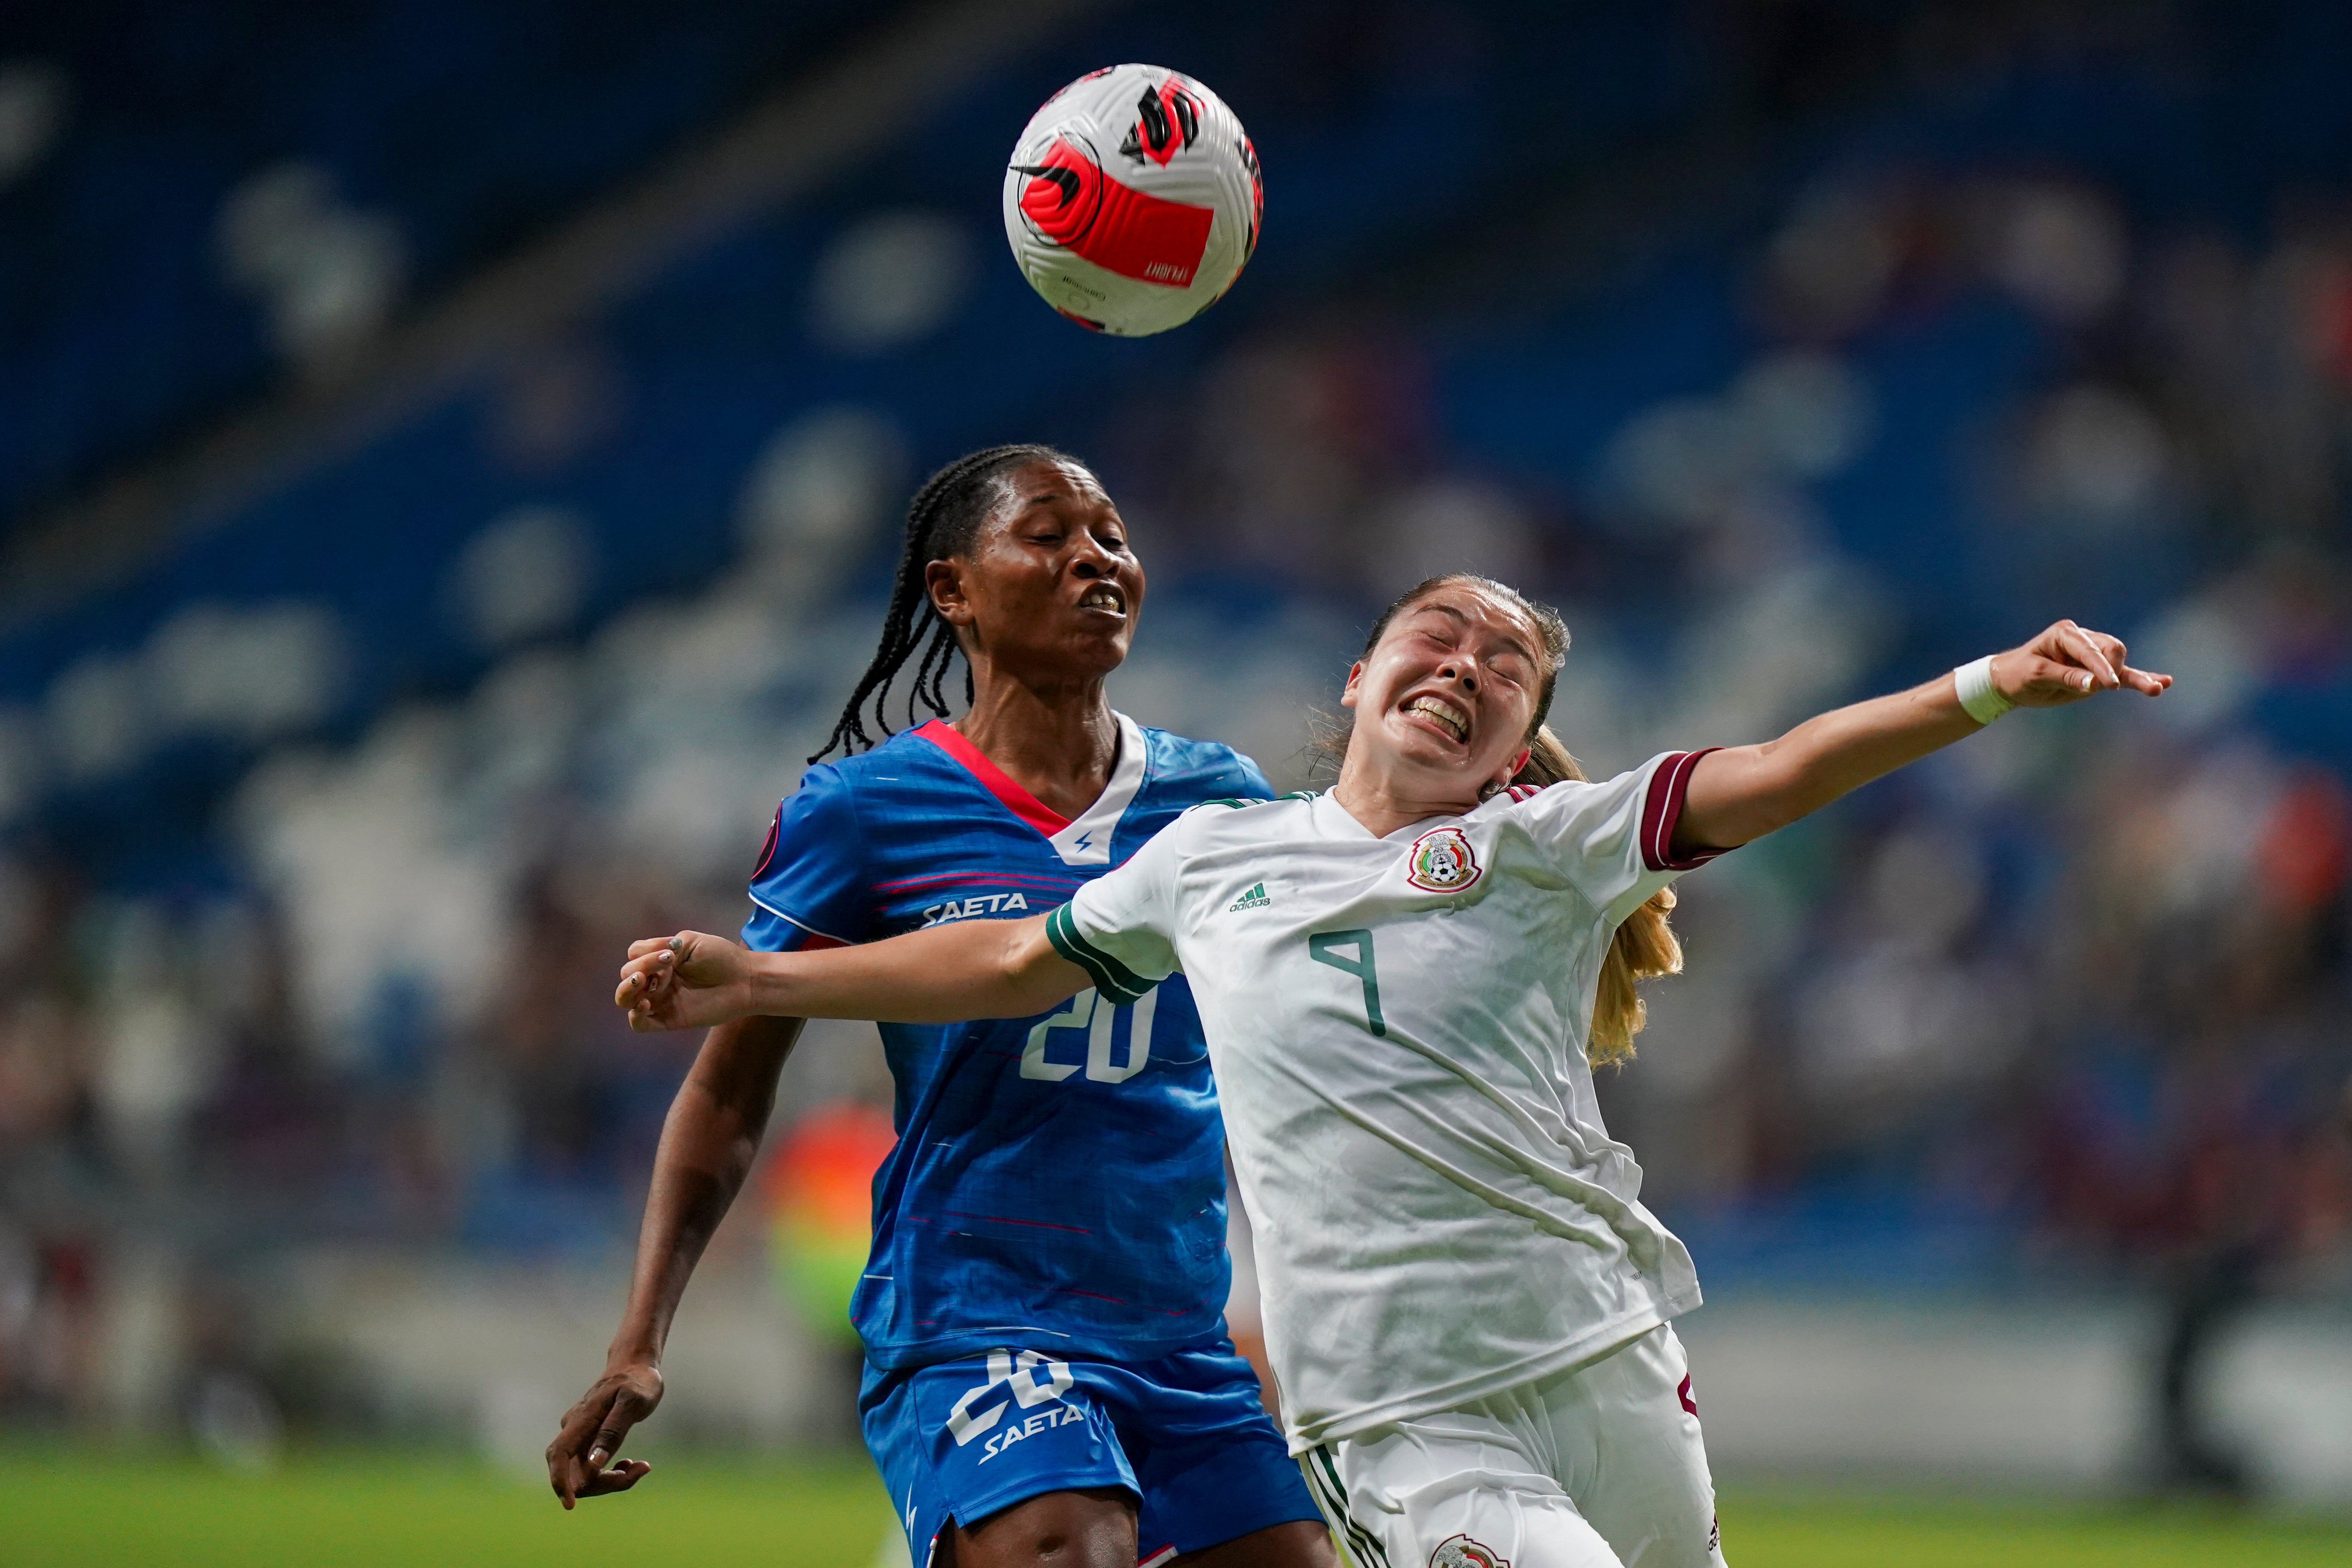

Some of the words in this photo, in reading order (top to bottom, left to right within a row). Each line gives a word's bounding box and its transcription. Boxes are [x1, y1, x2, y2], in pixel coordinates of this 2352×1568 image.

[920, 893, 1028, 929] SAETA
[1230, 897, 1270, 912] adidas
[1309, 929, 1386, 1036] 9
[1020, 984, 1158, 1084] 20
[946, 1348, 1074, 1447] 20
[978, 1405, 1085, 1466] SAETA
